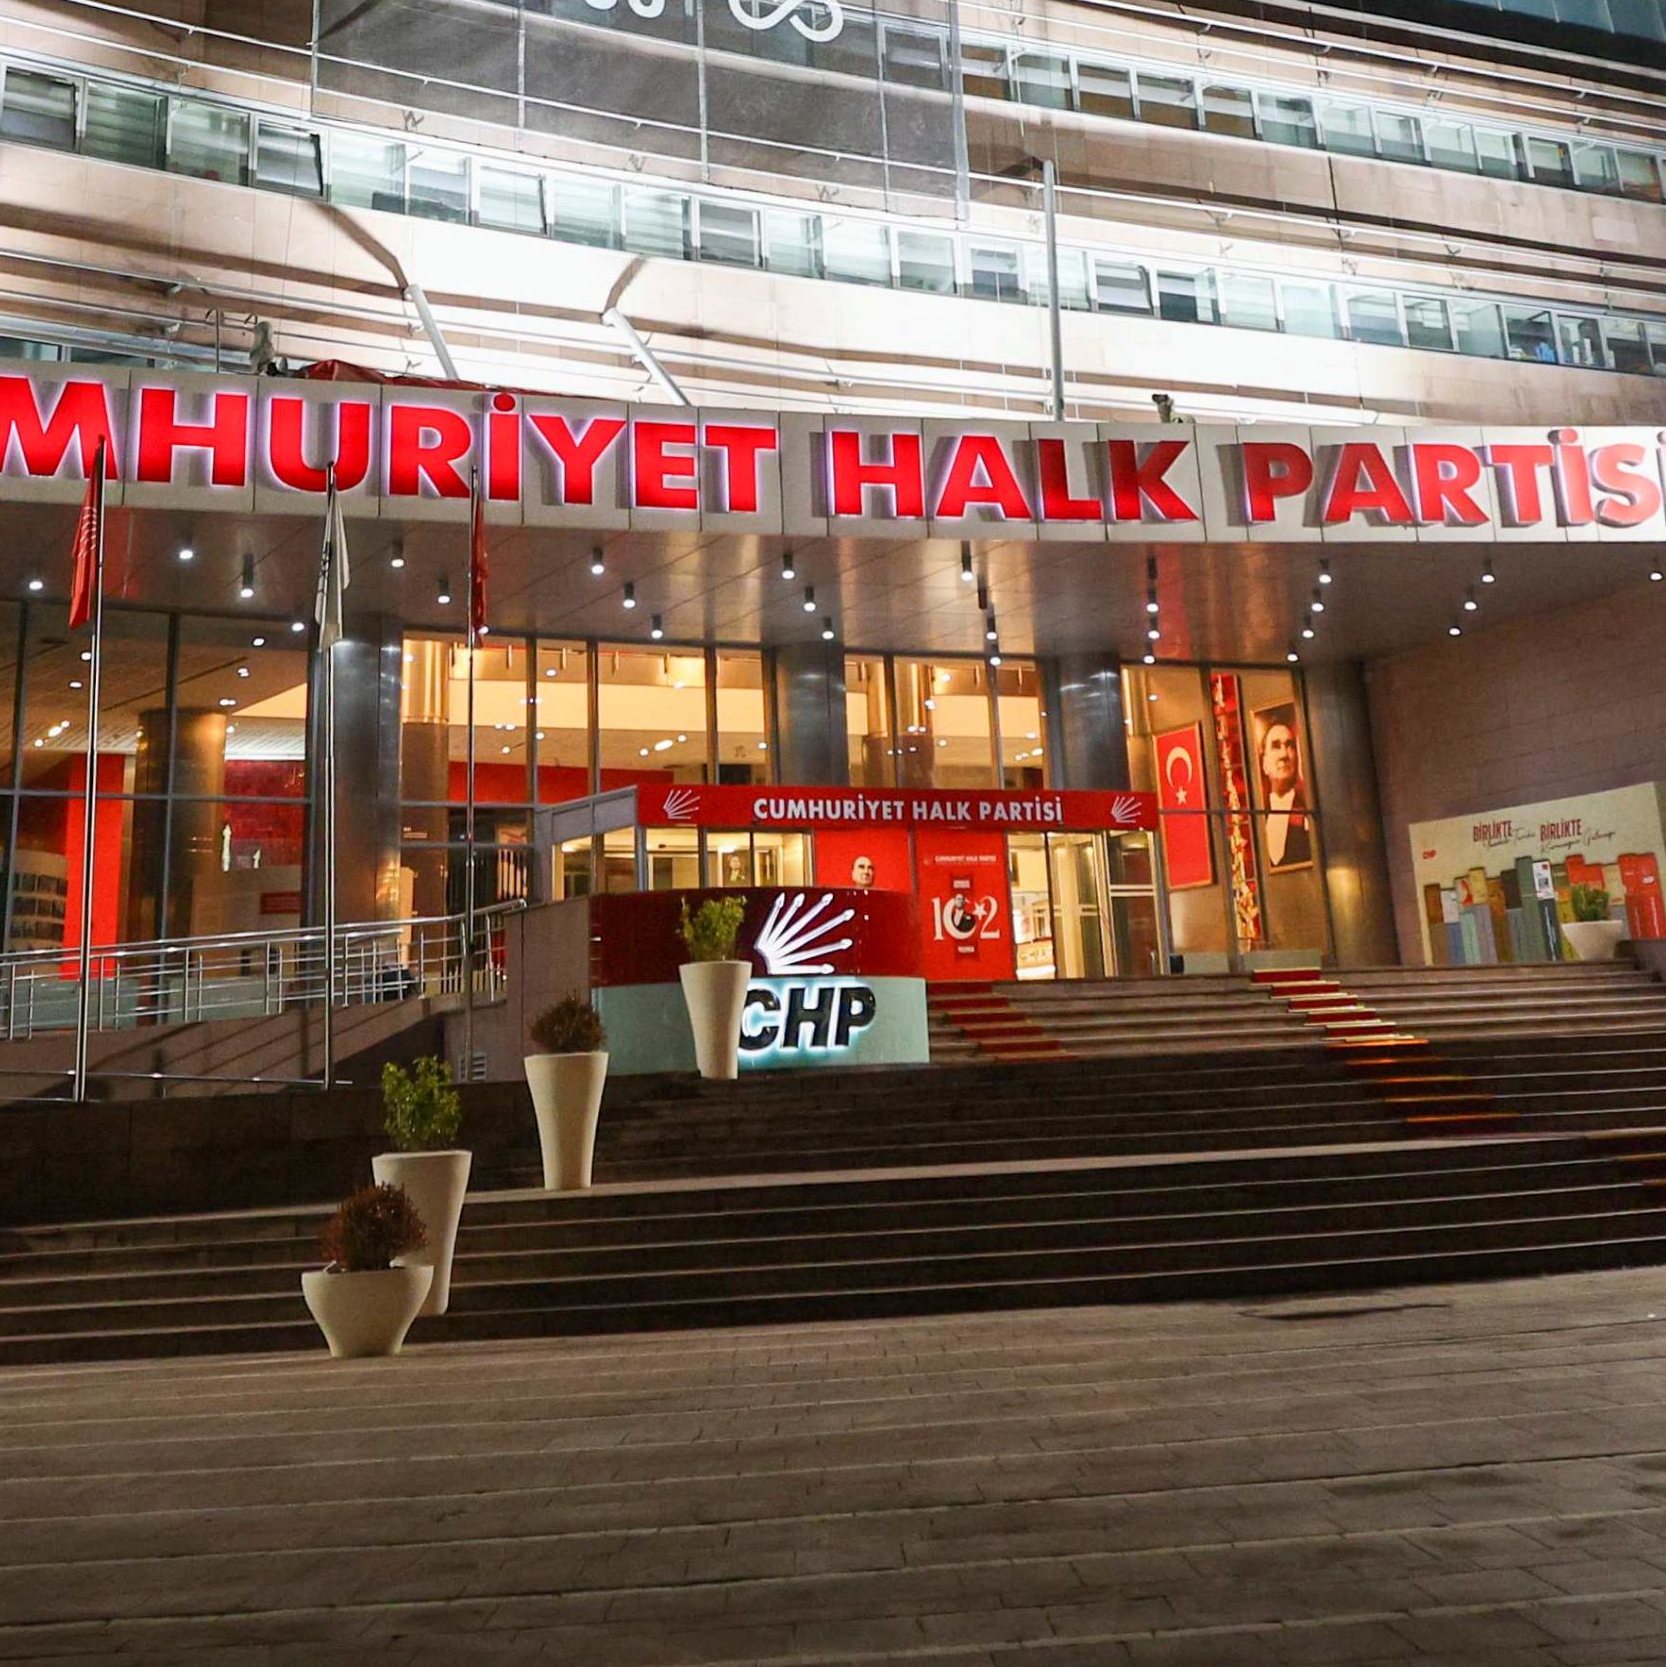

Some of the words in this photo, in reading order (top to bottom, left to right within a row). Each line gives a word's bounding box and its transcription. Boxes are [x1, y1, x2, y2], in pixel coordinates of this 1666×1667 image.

[831, 431, 1201, 522] HALK
[753, 793, 905, 821] CUMHURİYET
[913, 800, 971, 821] HALK
[979, 796, 1063, 823] PARTİSİ
[739, 987, 876, 1050] CHP
